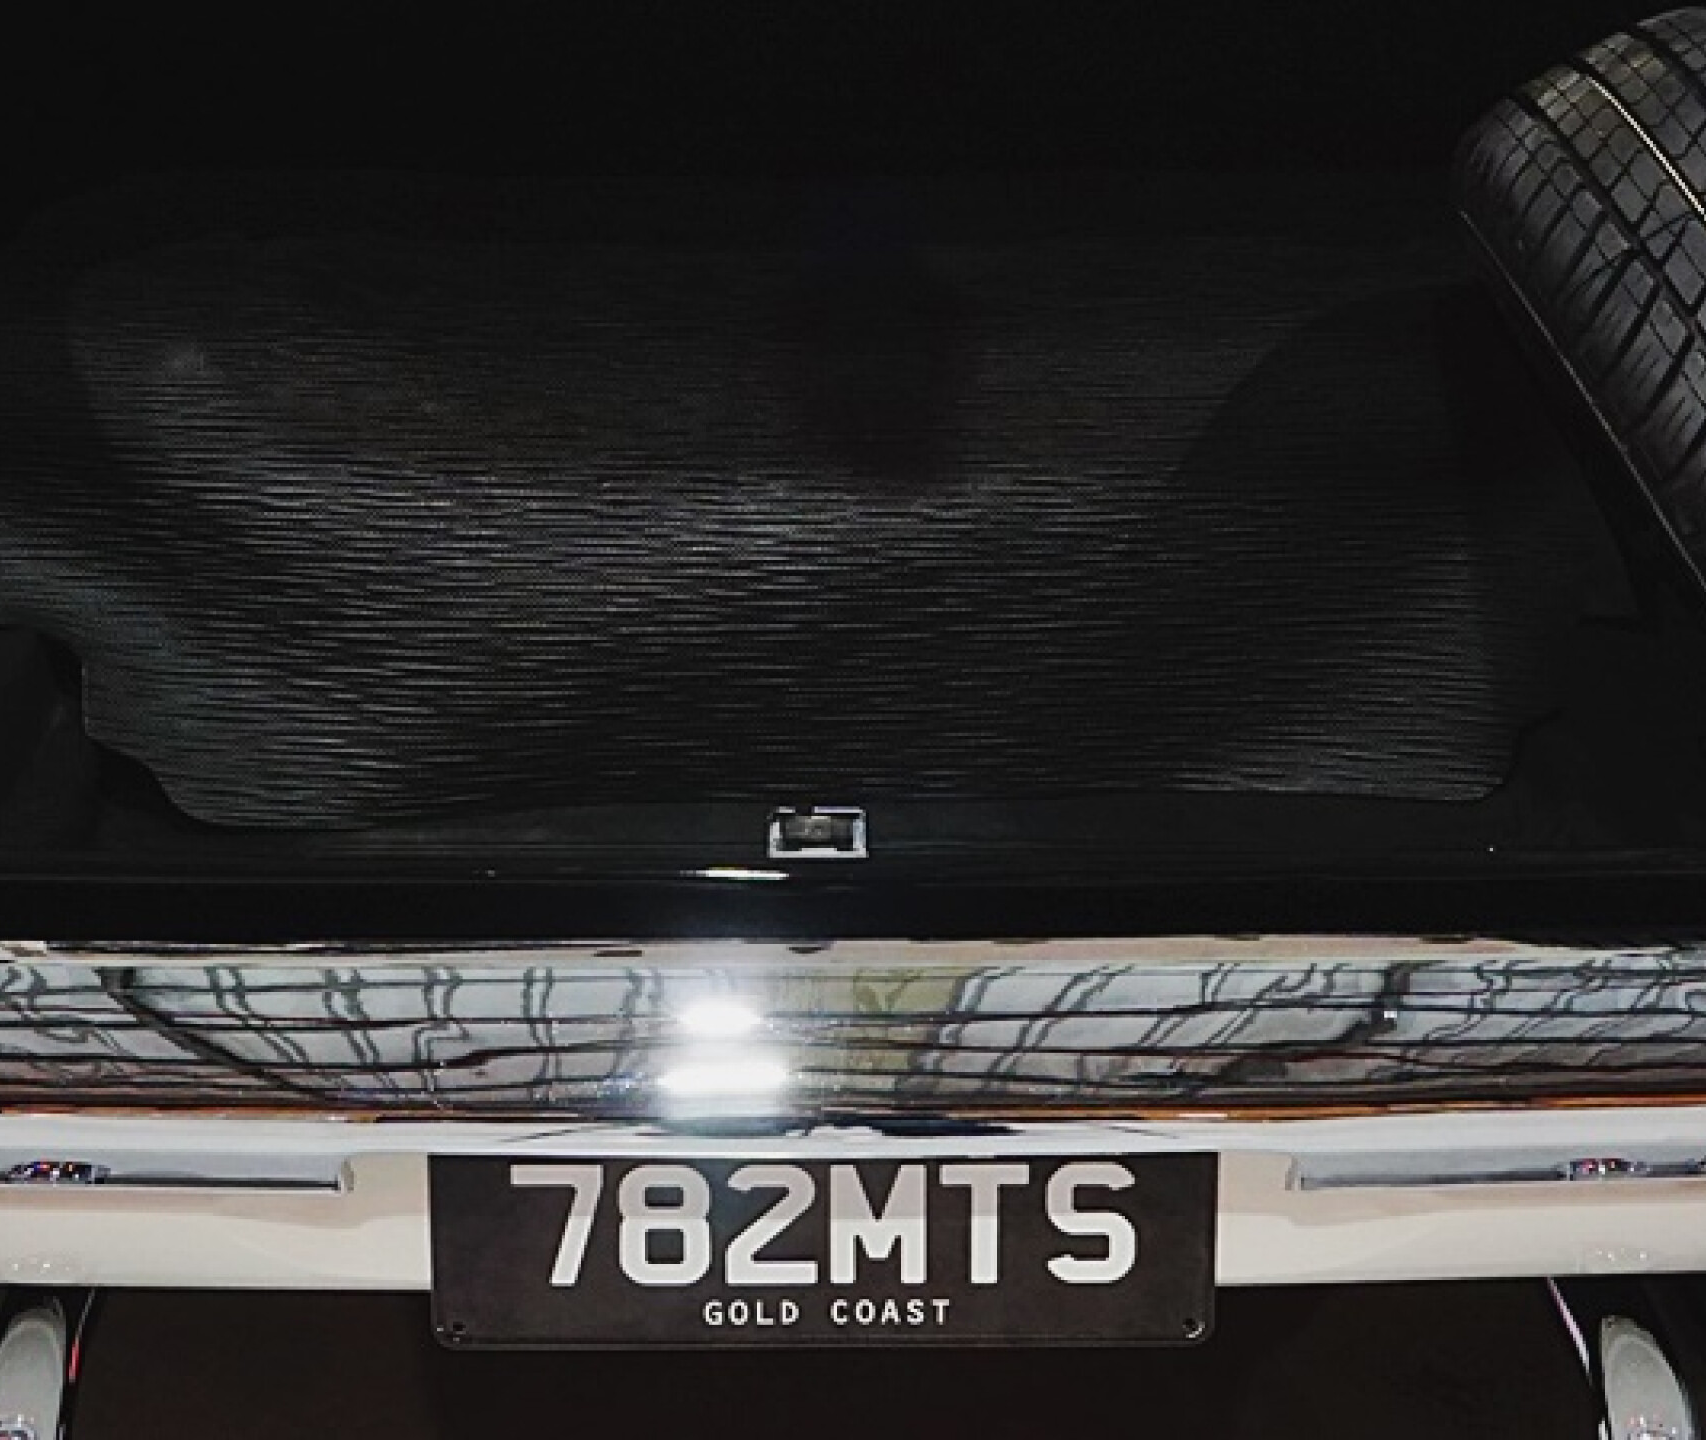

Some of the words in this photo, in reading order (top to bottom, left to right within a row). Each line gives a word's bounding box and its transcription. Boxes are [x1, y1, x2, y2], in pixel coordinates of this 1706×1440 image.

[510, 1163, 1137, 1288] 782MTS
[703, 1298, 801, 1327] GOLD
[830, 1298, 952, 1326] COAST
